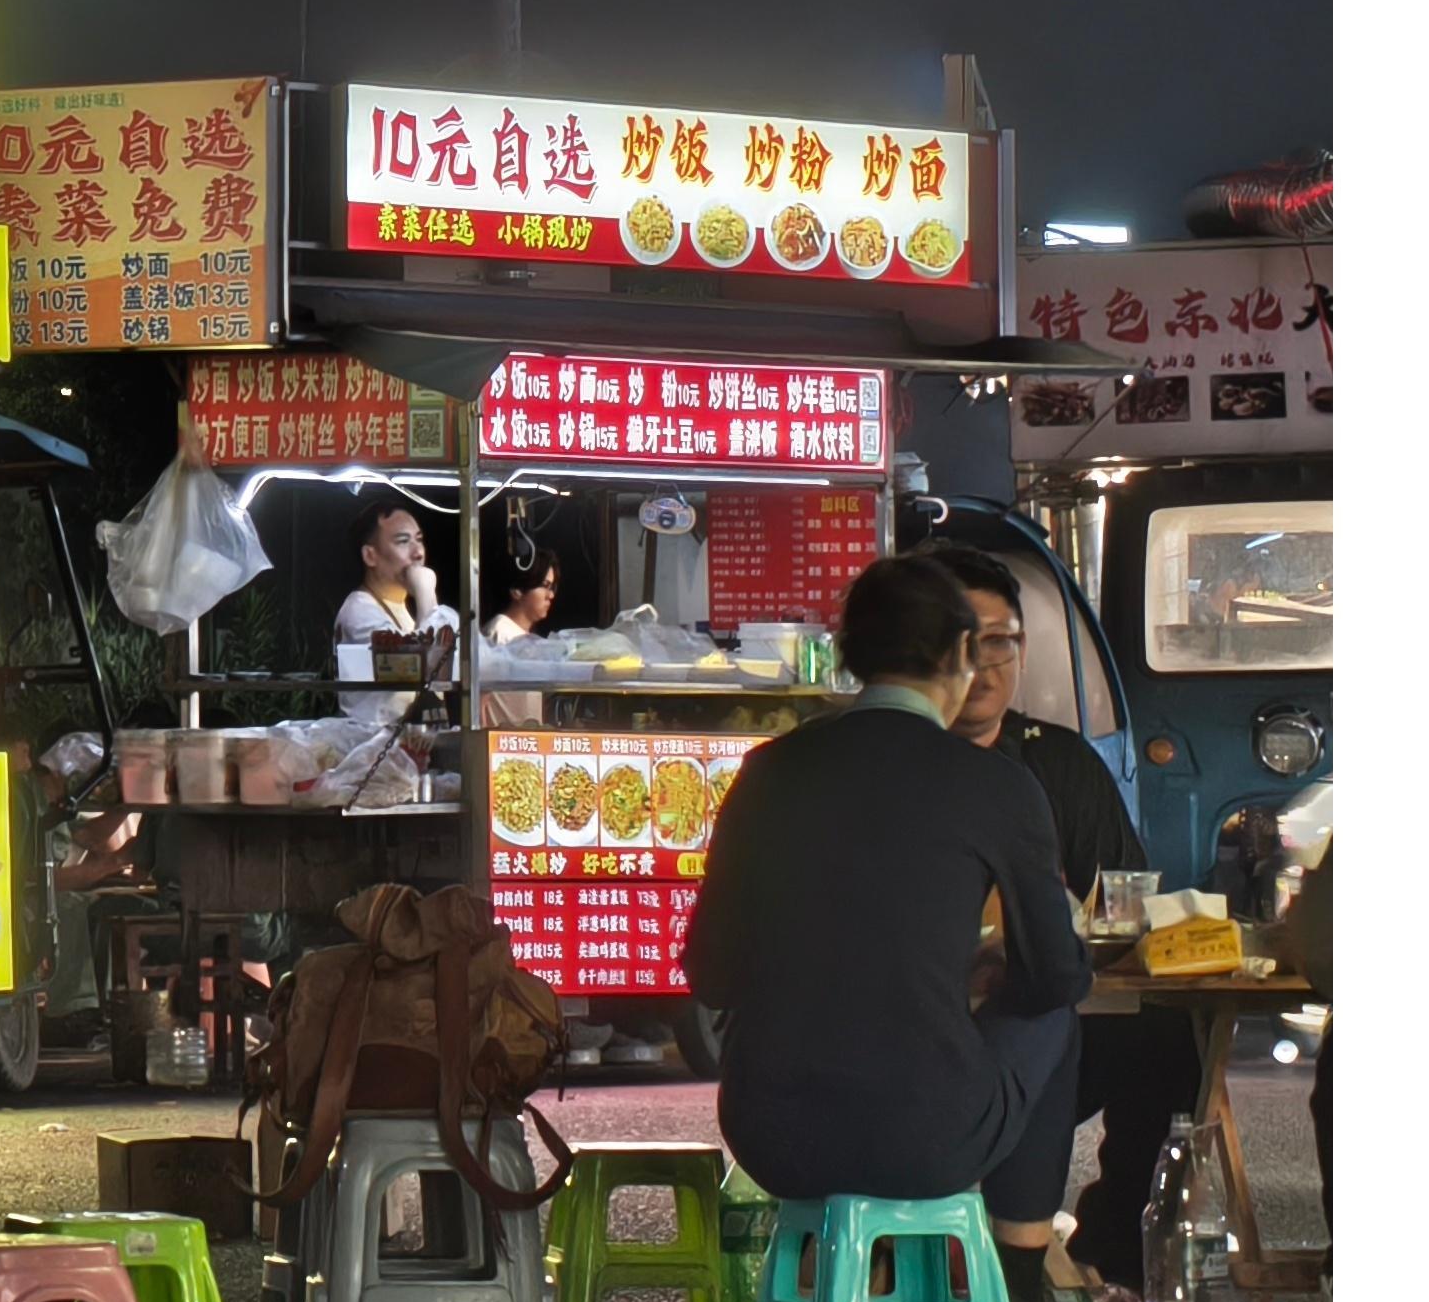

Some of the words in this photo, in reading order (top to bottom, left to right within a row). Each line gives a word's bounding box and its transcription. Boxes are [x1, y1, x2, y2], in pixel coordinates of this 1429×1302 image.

[371, 104, 598, 203] 10元自选
[621, 113, 715, 187] 炒饭
[744, 122, 832, 193] 炒粉
[862, 133, 948, 203] 炒面
[377, 201, 476, 246] 素菜任选
[497, 214, 593, 251] 小锅现炒
[37, 256, 87, 281] 10元
[121, 252, 170, 279] 炒面
[199, 250, 252, 275] 10元
[38, 287, 88, 313] 10元
[121, 283, 195, 311] 盖浇饭
[198, 282, 250, 307] 13元
[40, 319, 89, 345] 13元
[121, 316, 171, 343] 砂锅
[199, 314, 250, 340] 15元
[191, 358, 230, 404] 炒面
[236, 359, 275, 403] 炒饭
[280, 356, 340, 403] 炒米粉
[277, 412, 336, 458] 炒饼丝
[343, 411, 406, 458] 炒年糕
[728, 418, 778, 458] 盖浇饭
[789, 420, 855, 461] 酒水饮料
[581, 851, 657, 877] 好吃不贵
